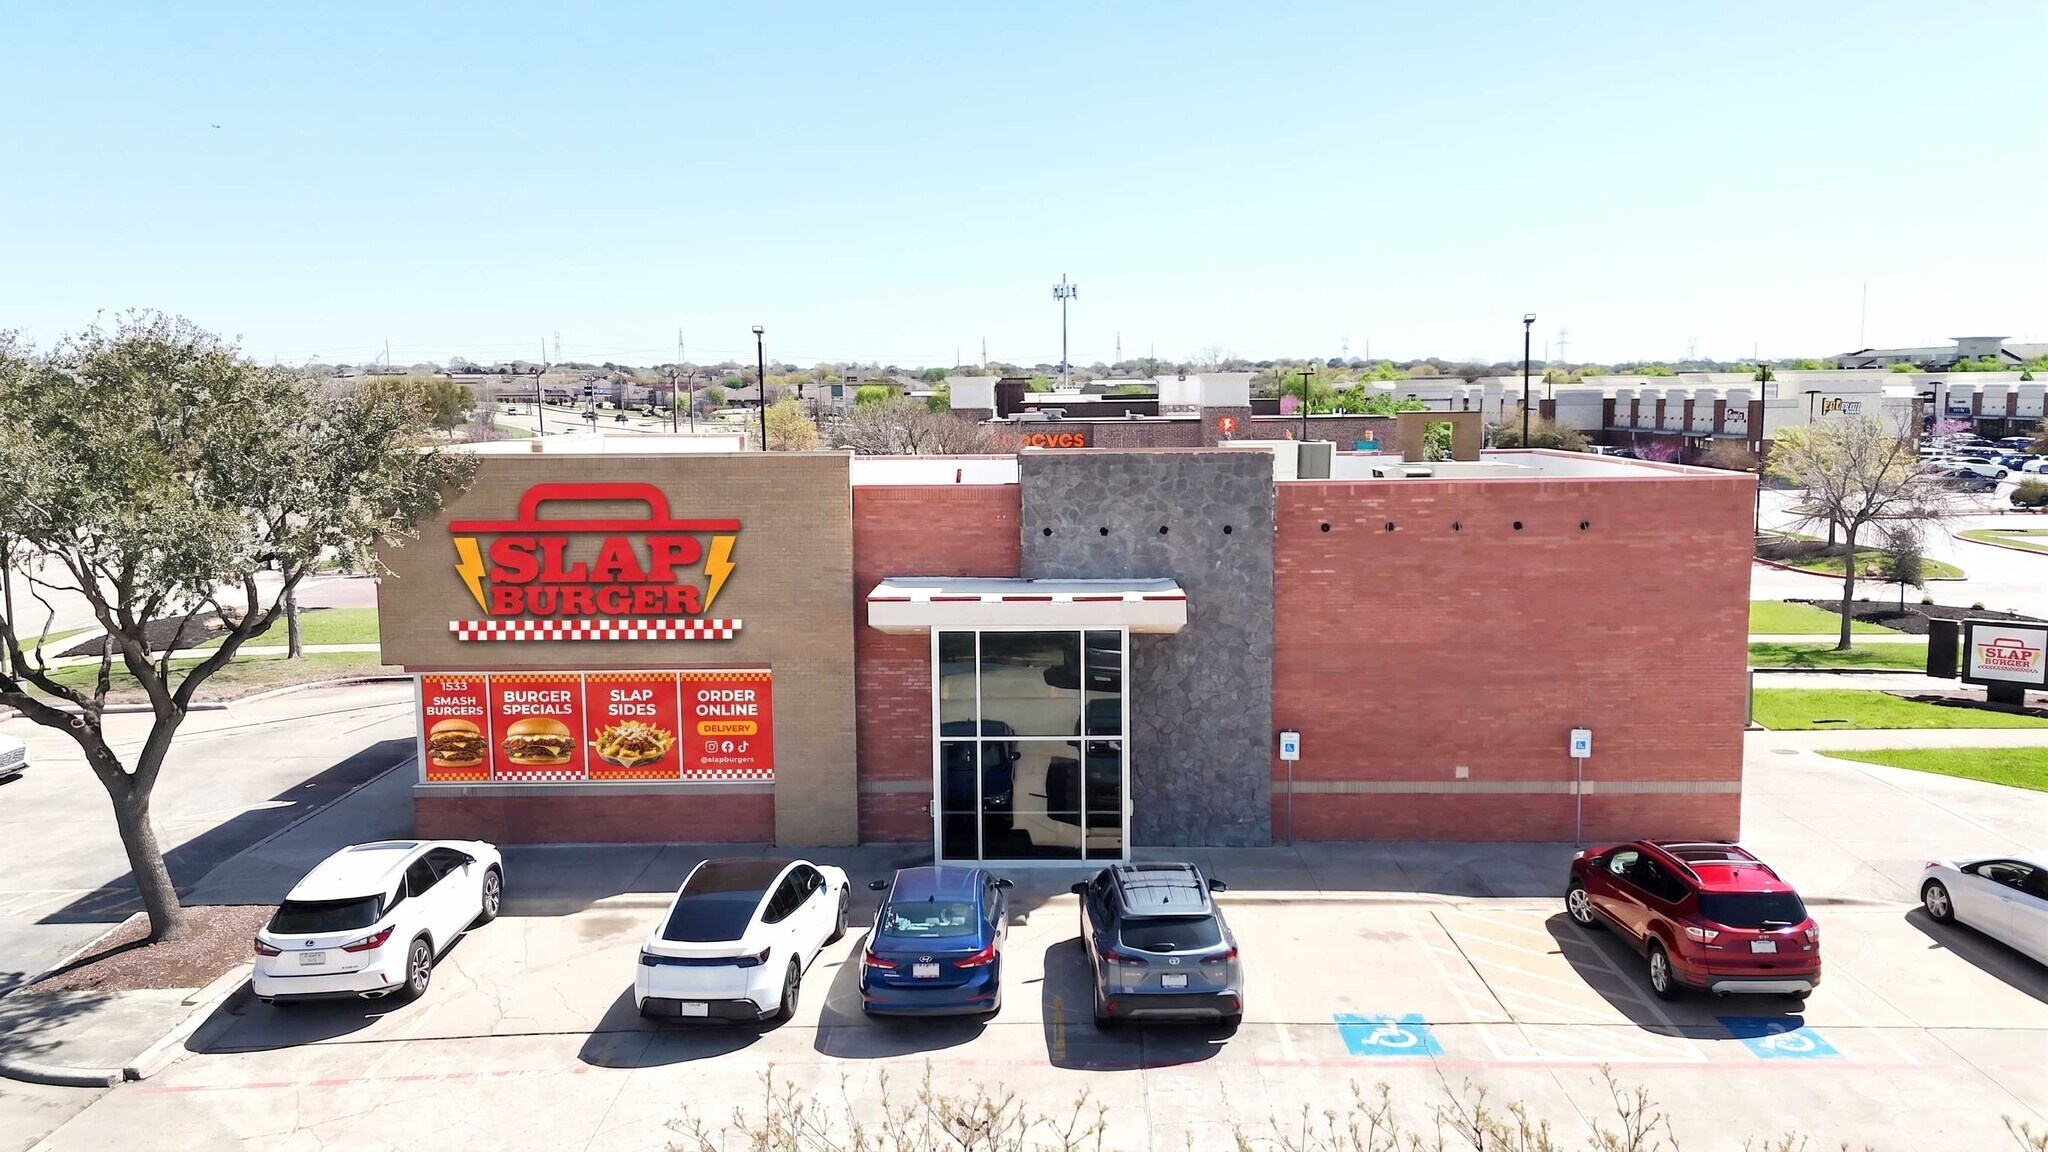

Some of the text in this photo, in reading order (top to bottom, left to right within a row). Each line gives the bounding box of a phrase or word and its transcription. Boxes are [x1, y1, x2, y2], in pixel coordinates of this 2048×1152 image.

[489, 535, 702, 584] SLAP
[490, 585, 702, 616] BURGER
[1985, 648, 2033, 660] SLAP
[441, 682, 468, 691] 1533
[433, 696, 476, 706] SMASH
[503, 690, 571, 703] BURGER
[610, 689, 653, 702] SLAP
[697, 689, 755, 702] ORDER
[426, 706, 484, 716] BURGERS
[503, 704, 573, 715] SPECIALS
[608, 703, 657, 716] SIDES
[696, 704, 758, 716] ONLINE
[704, 724, 751, 732] DELIVERY
[700, 756, 755, 764] @slapburgers
